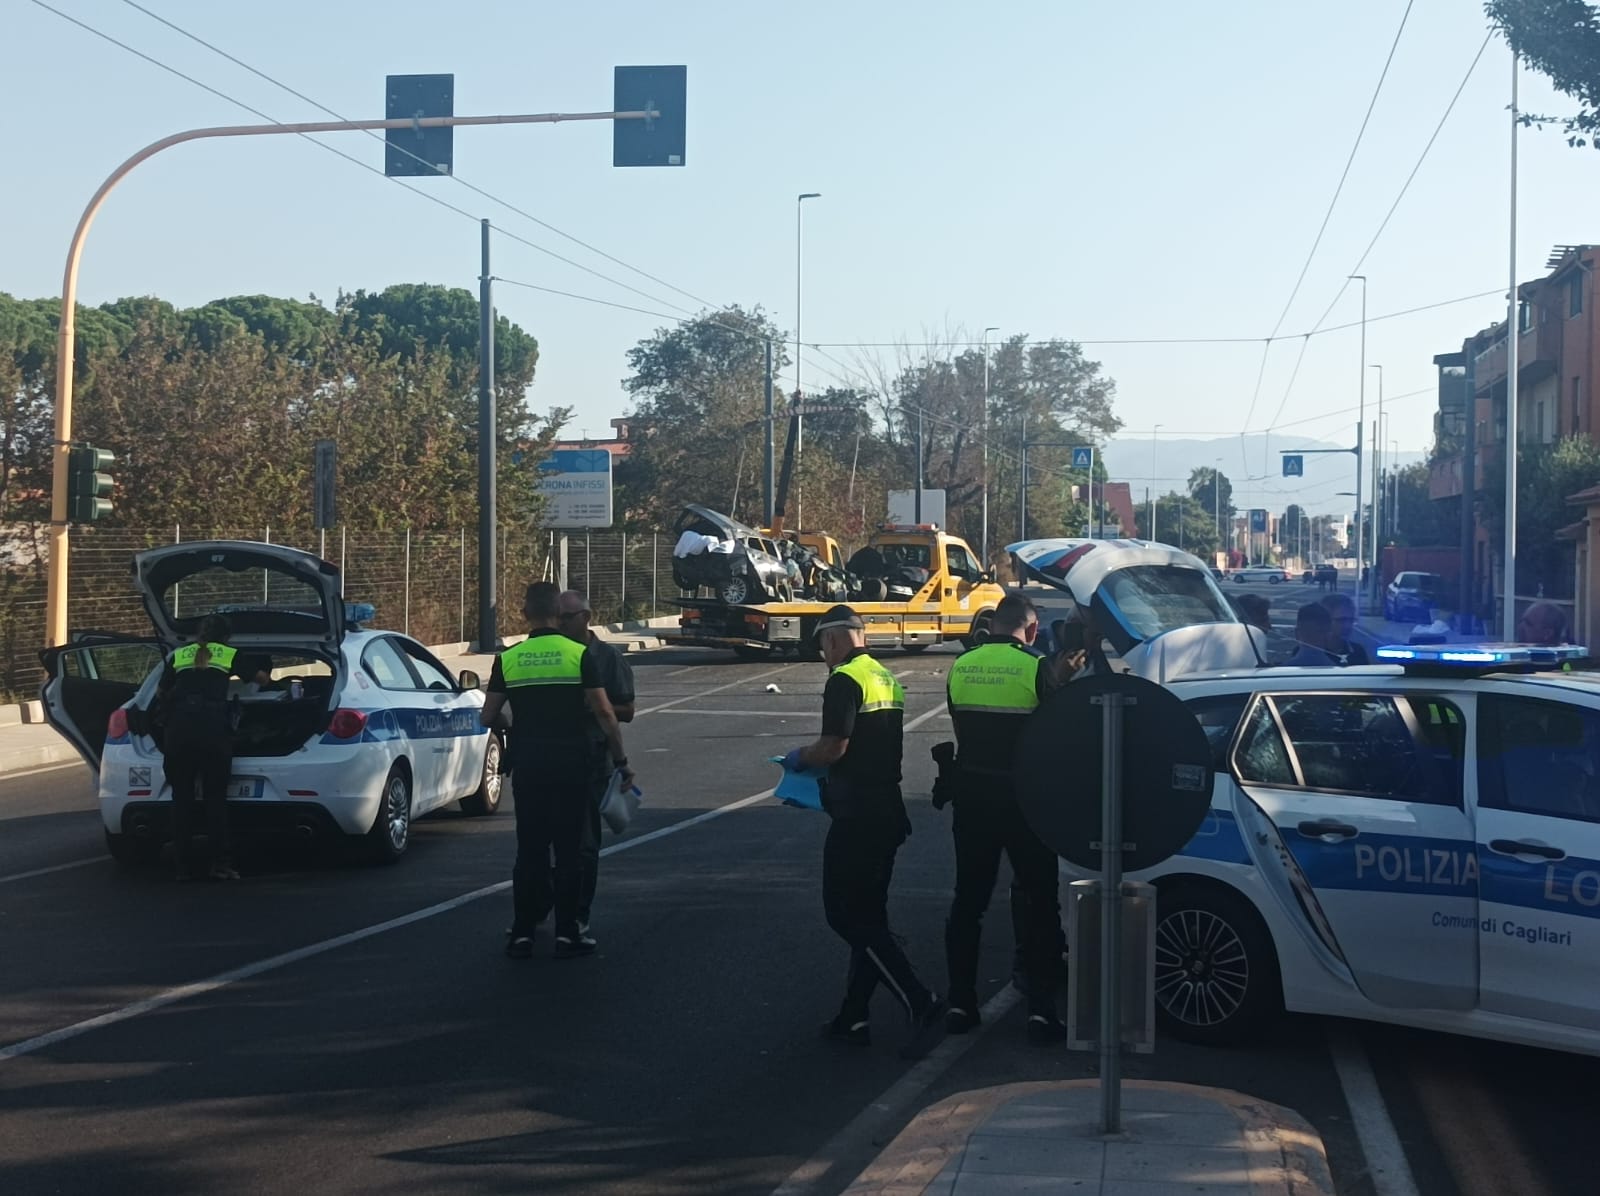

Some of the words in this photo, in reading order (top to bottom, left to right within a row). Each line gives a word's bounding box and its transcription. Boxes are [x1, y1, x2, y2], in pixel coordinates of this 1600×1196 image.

[573, 480, 605, 489] INFISSI
[517, 650, 562, 658] POLIZIA
[517, 658, 563, 666] LOCALE
[987, 666, 1023, 676] LOCALE
[964, 676, 1005, 685] CAGLIARI
[415, 714, 442, 733] POLIZIA
[1354, 843, 1478, 886] POLIZIA
[1543, 864, 1600, 907] LO
[1431, 911, 1478, 928] Comun
[1480, 917, 1497, 933] di
[1502, 920, 1572, 946] Cagliari
